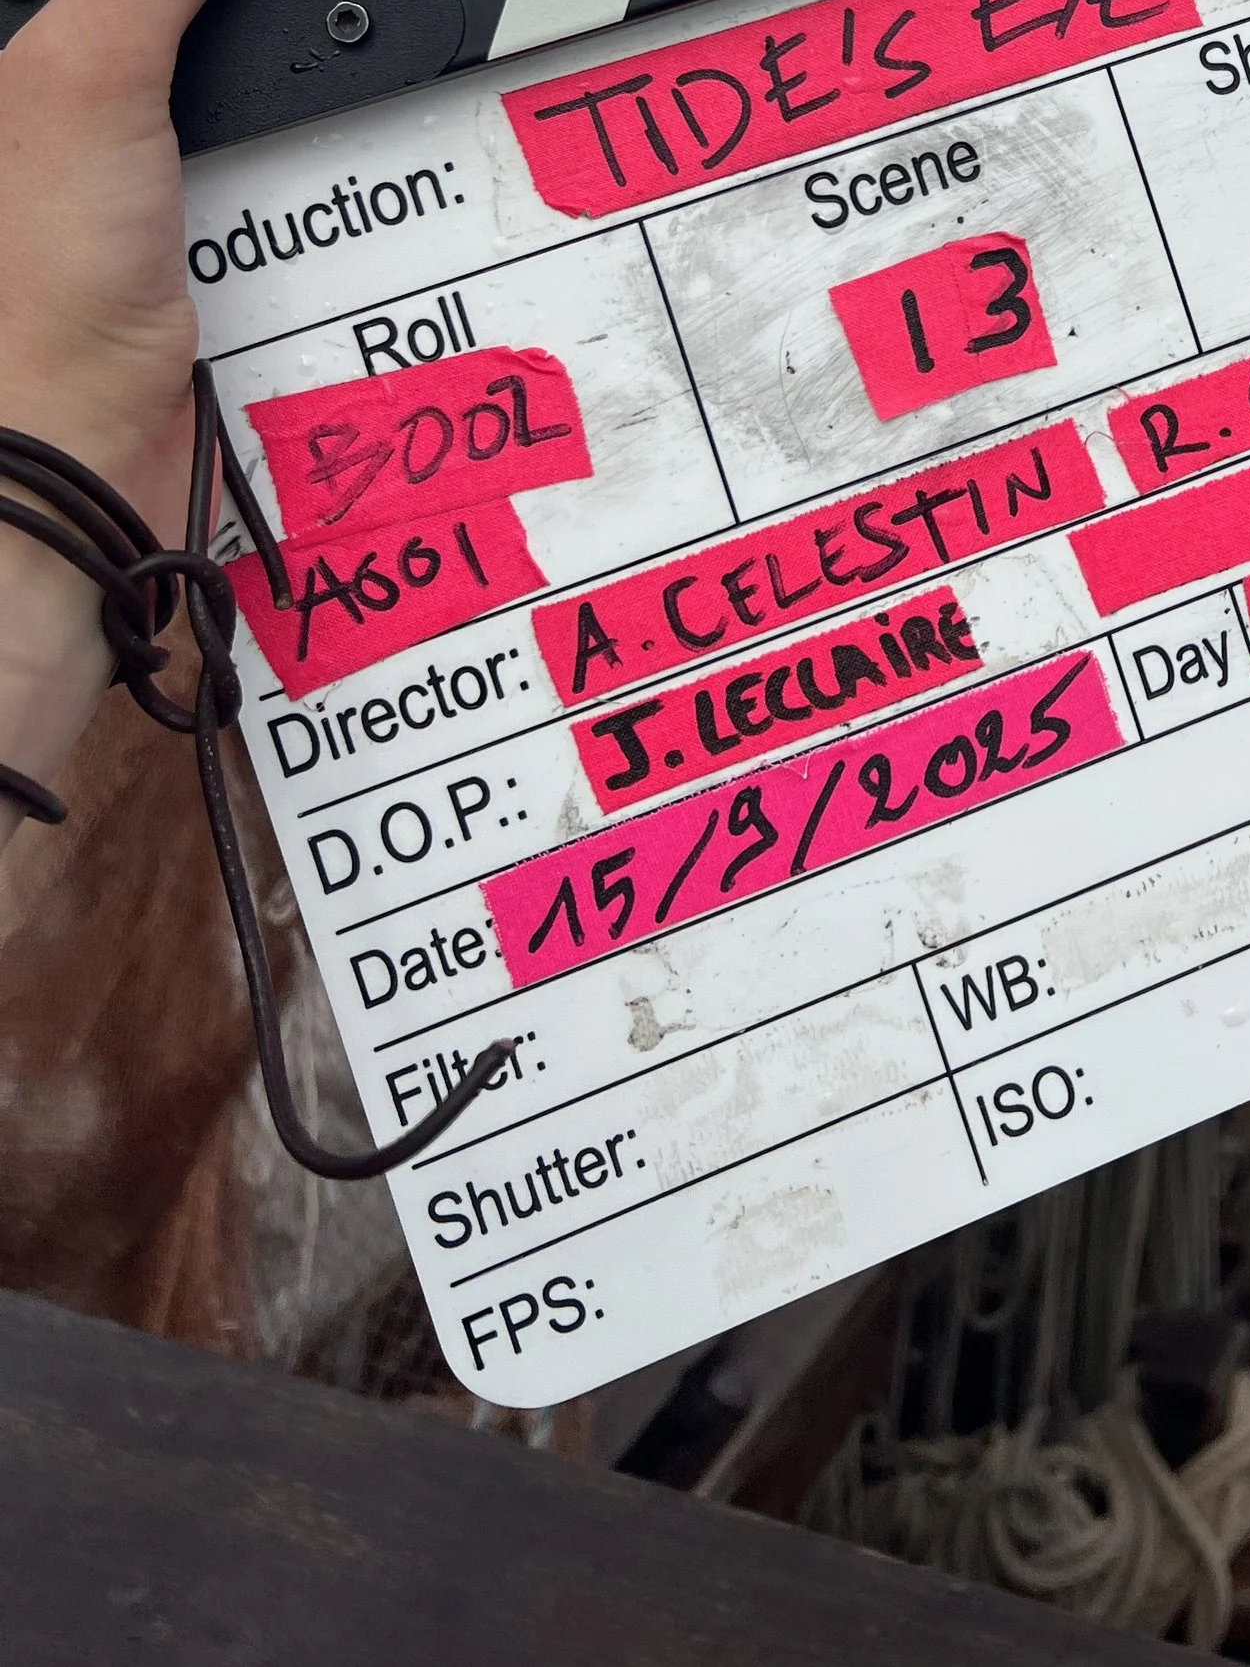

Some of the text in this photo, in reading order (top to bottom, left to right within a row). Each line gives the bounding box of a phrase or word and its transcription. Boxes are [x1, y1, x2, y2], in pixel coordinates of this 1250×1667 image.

[534, 8, 932, 187] TIDE'S
[187, 161, 465, 284] oduction:
[803, 140, 982, 228] Scene
[352, 291, 477, 377] Roll
[900, 246, 1031, 374] 13
[1139, 403, 1233, 473] R.
[662, 445, 1052, 653] CELESTIN
[267, 647, 531, 779] Director:
[1133, 627, 1229, 701] Day
[591, 697, 684, 792] J.
[306, 773, 528, 896] D.O.P.:
[528, 652, 1092, 955] 15/9/2025
[940, 954, 1058, 1032] WB:
[974, 1064, 1094, 1148] ISO:
[426, 1129, 646, 1250] Shutter:
[460, 1275, 606, 1372] FPS:
